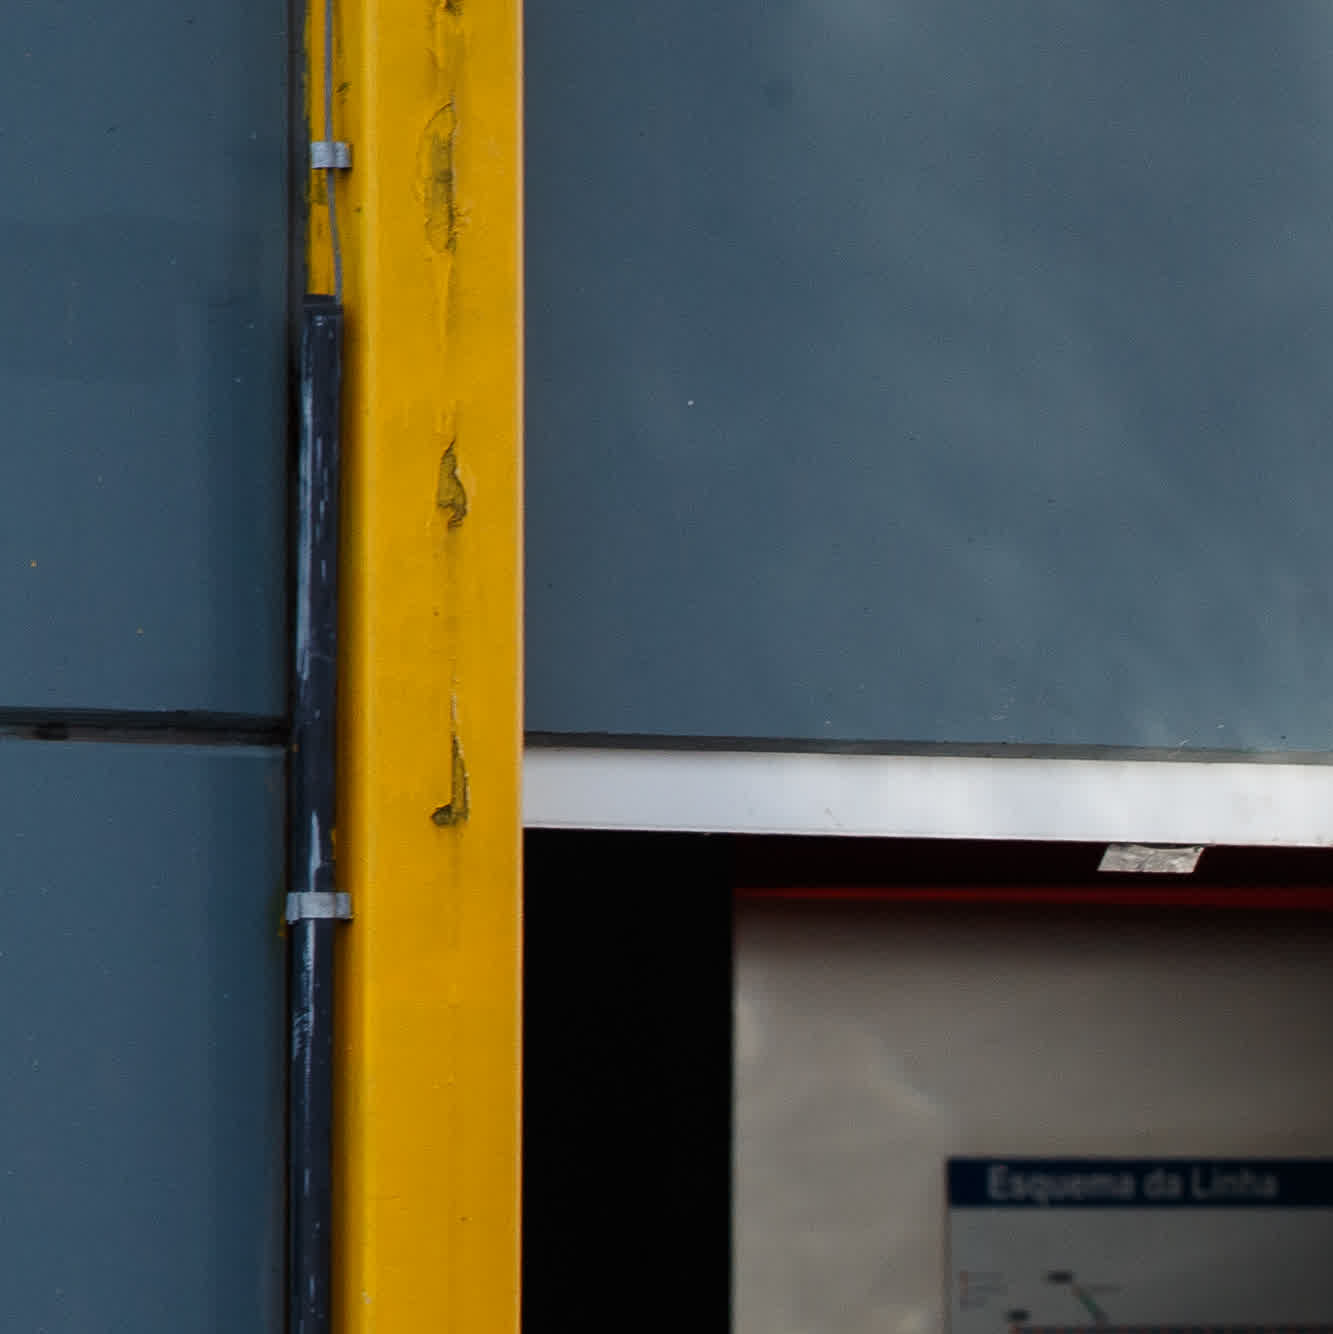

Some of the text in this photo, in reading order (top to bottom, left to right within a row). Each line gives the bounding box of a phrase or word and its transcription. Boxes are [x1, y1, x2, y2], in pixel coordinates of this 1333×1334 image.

[986, 1164, 1281, 1207] Esquema da Linha
